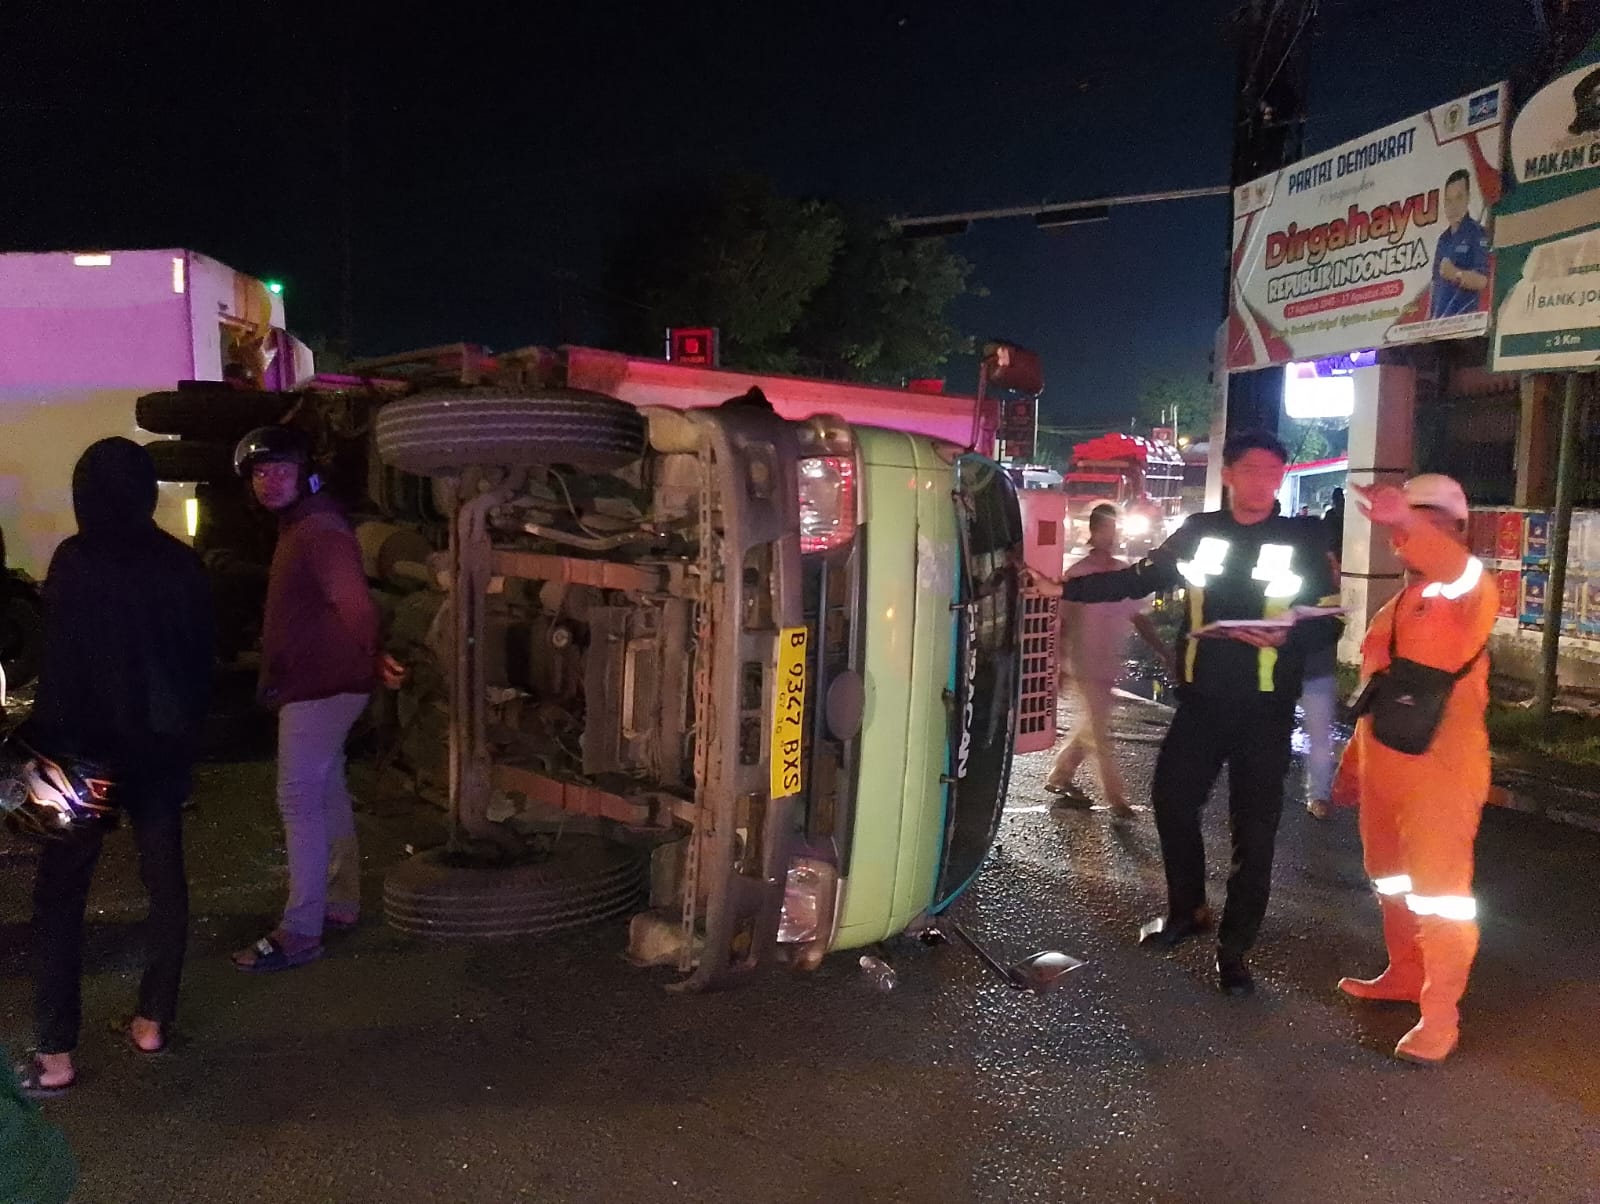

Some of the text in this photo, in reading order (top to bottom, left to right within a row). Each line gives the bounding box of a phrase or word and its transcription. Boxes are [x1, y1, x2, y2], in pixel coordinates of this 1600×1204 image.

[1289, 158, 1333, 196] PARTAI
[1337, 127, 1416, 178] DEMOKRAT
[1525, 145, 1585, 179] MAKAM
[1265, 188, 1440, 270] Dirgahayu
[1267, 237, 1429, 304] REPUBLIK INDONESIA
[1538, 292, 1576, 308] BANK
[1562, 334, 1581, 345] Km
[790, 632, 805, 648] B
[783, 739, 799, 790] BXS
